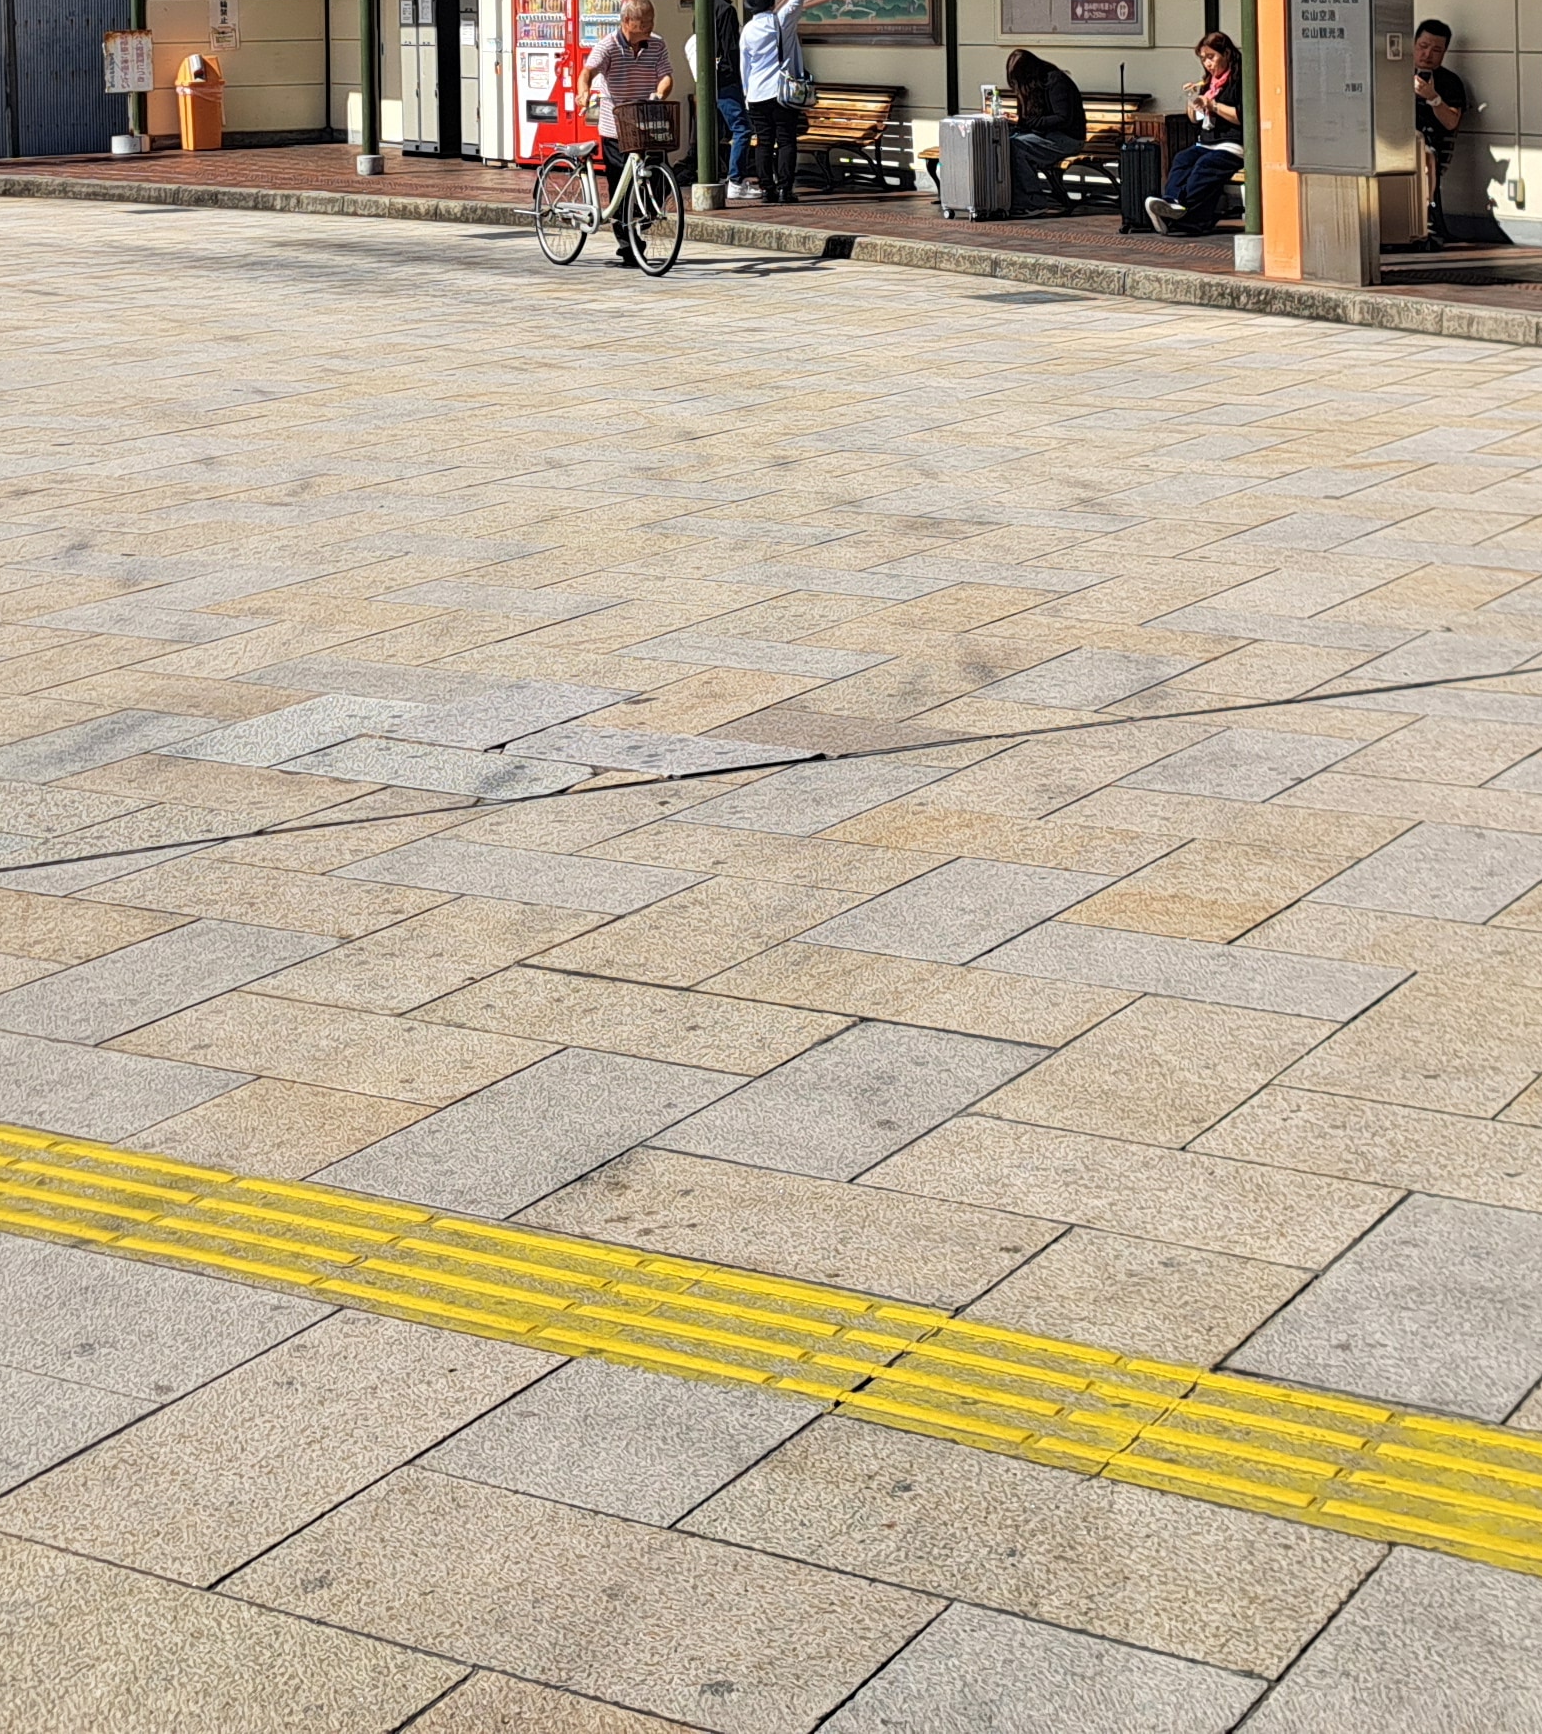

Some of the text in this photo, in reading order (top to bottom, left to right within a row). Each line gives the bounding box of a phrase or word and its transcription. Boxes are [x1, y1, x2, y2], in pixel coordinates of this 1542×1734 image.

[1301, 9, 1336, 22] 松山空港
[1301, 27, 1345, 39] 松山観光港
